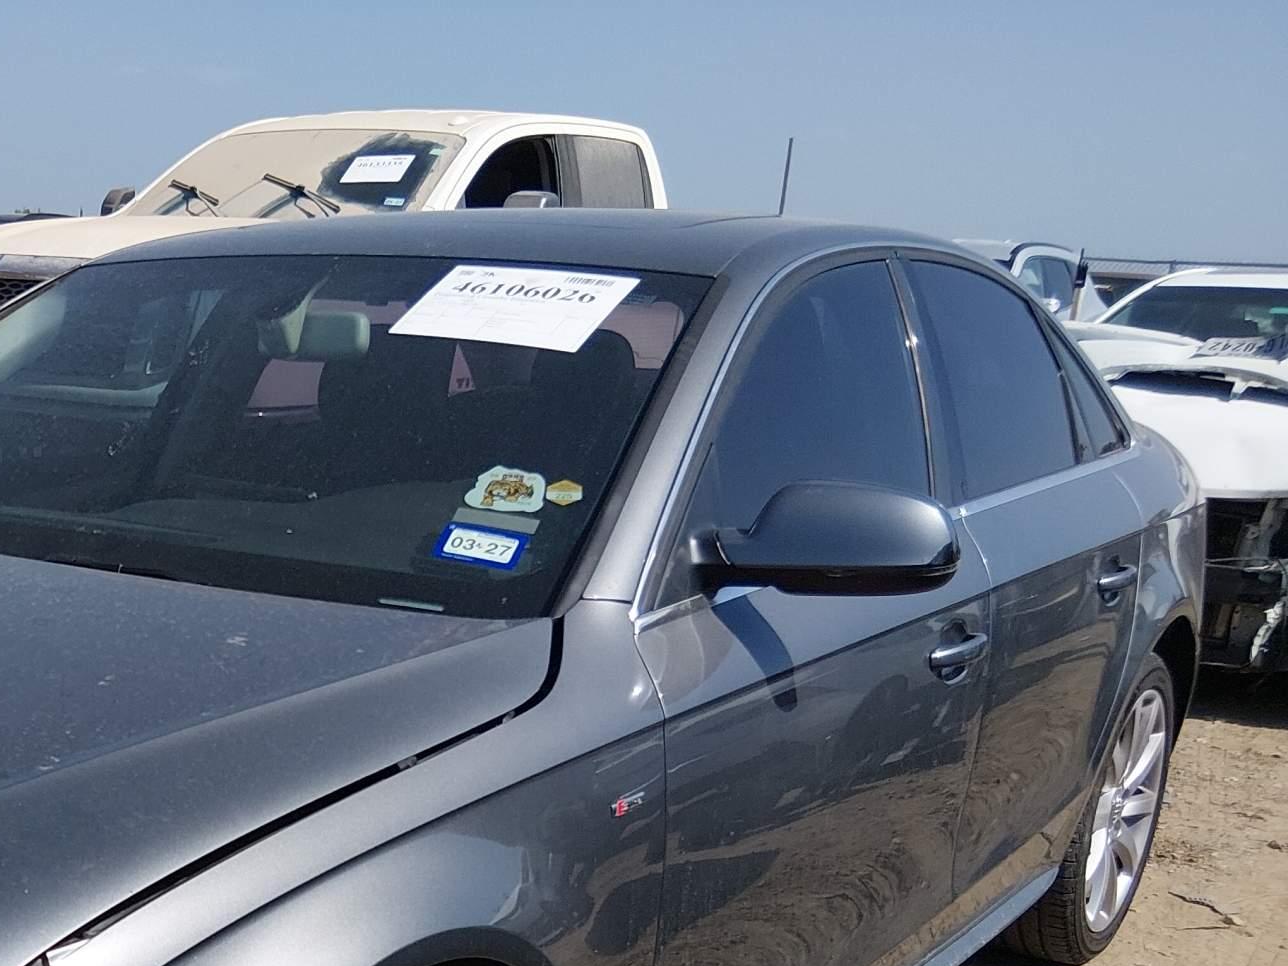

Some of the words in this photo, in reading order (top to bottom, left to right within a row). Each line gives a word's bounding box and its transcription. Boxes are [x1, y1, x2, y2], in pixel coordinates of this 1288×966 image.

[451, 280, 597, 304] 46106026
[449, 536, 474, 551] 03
[484, 541, 513, 557] 27
